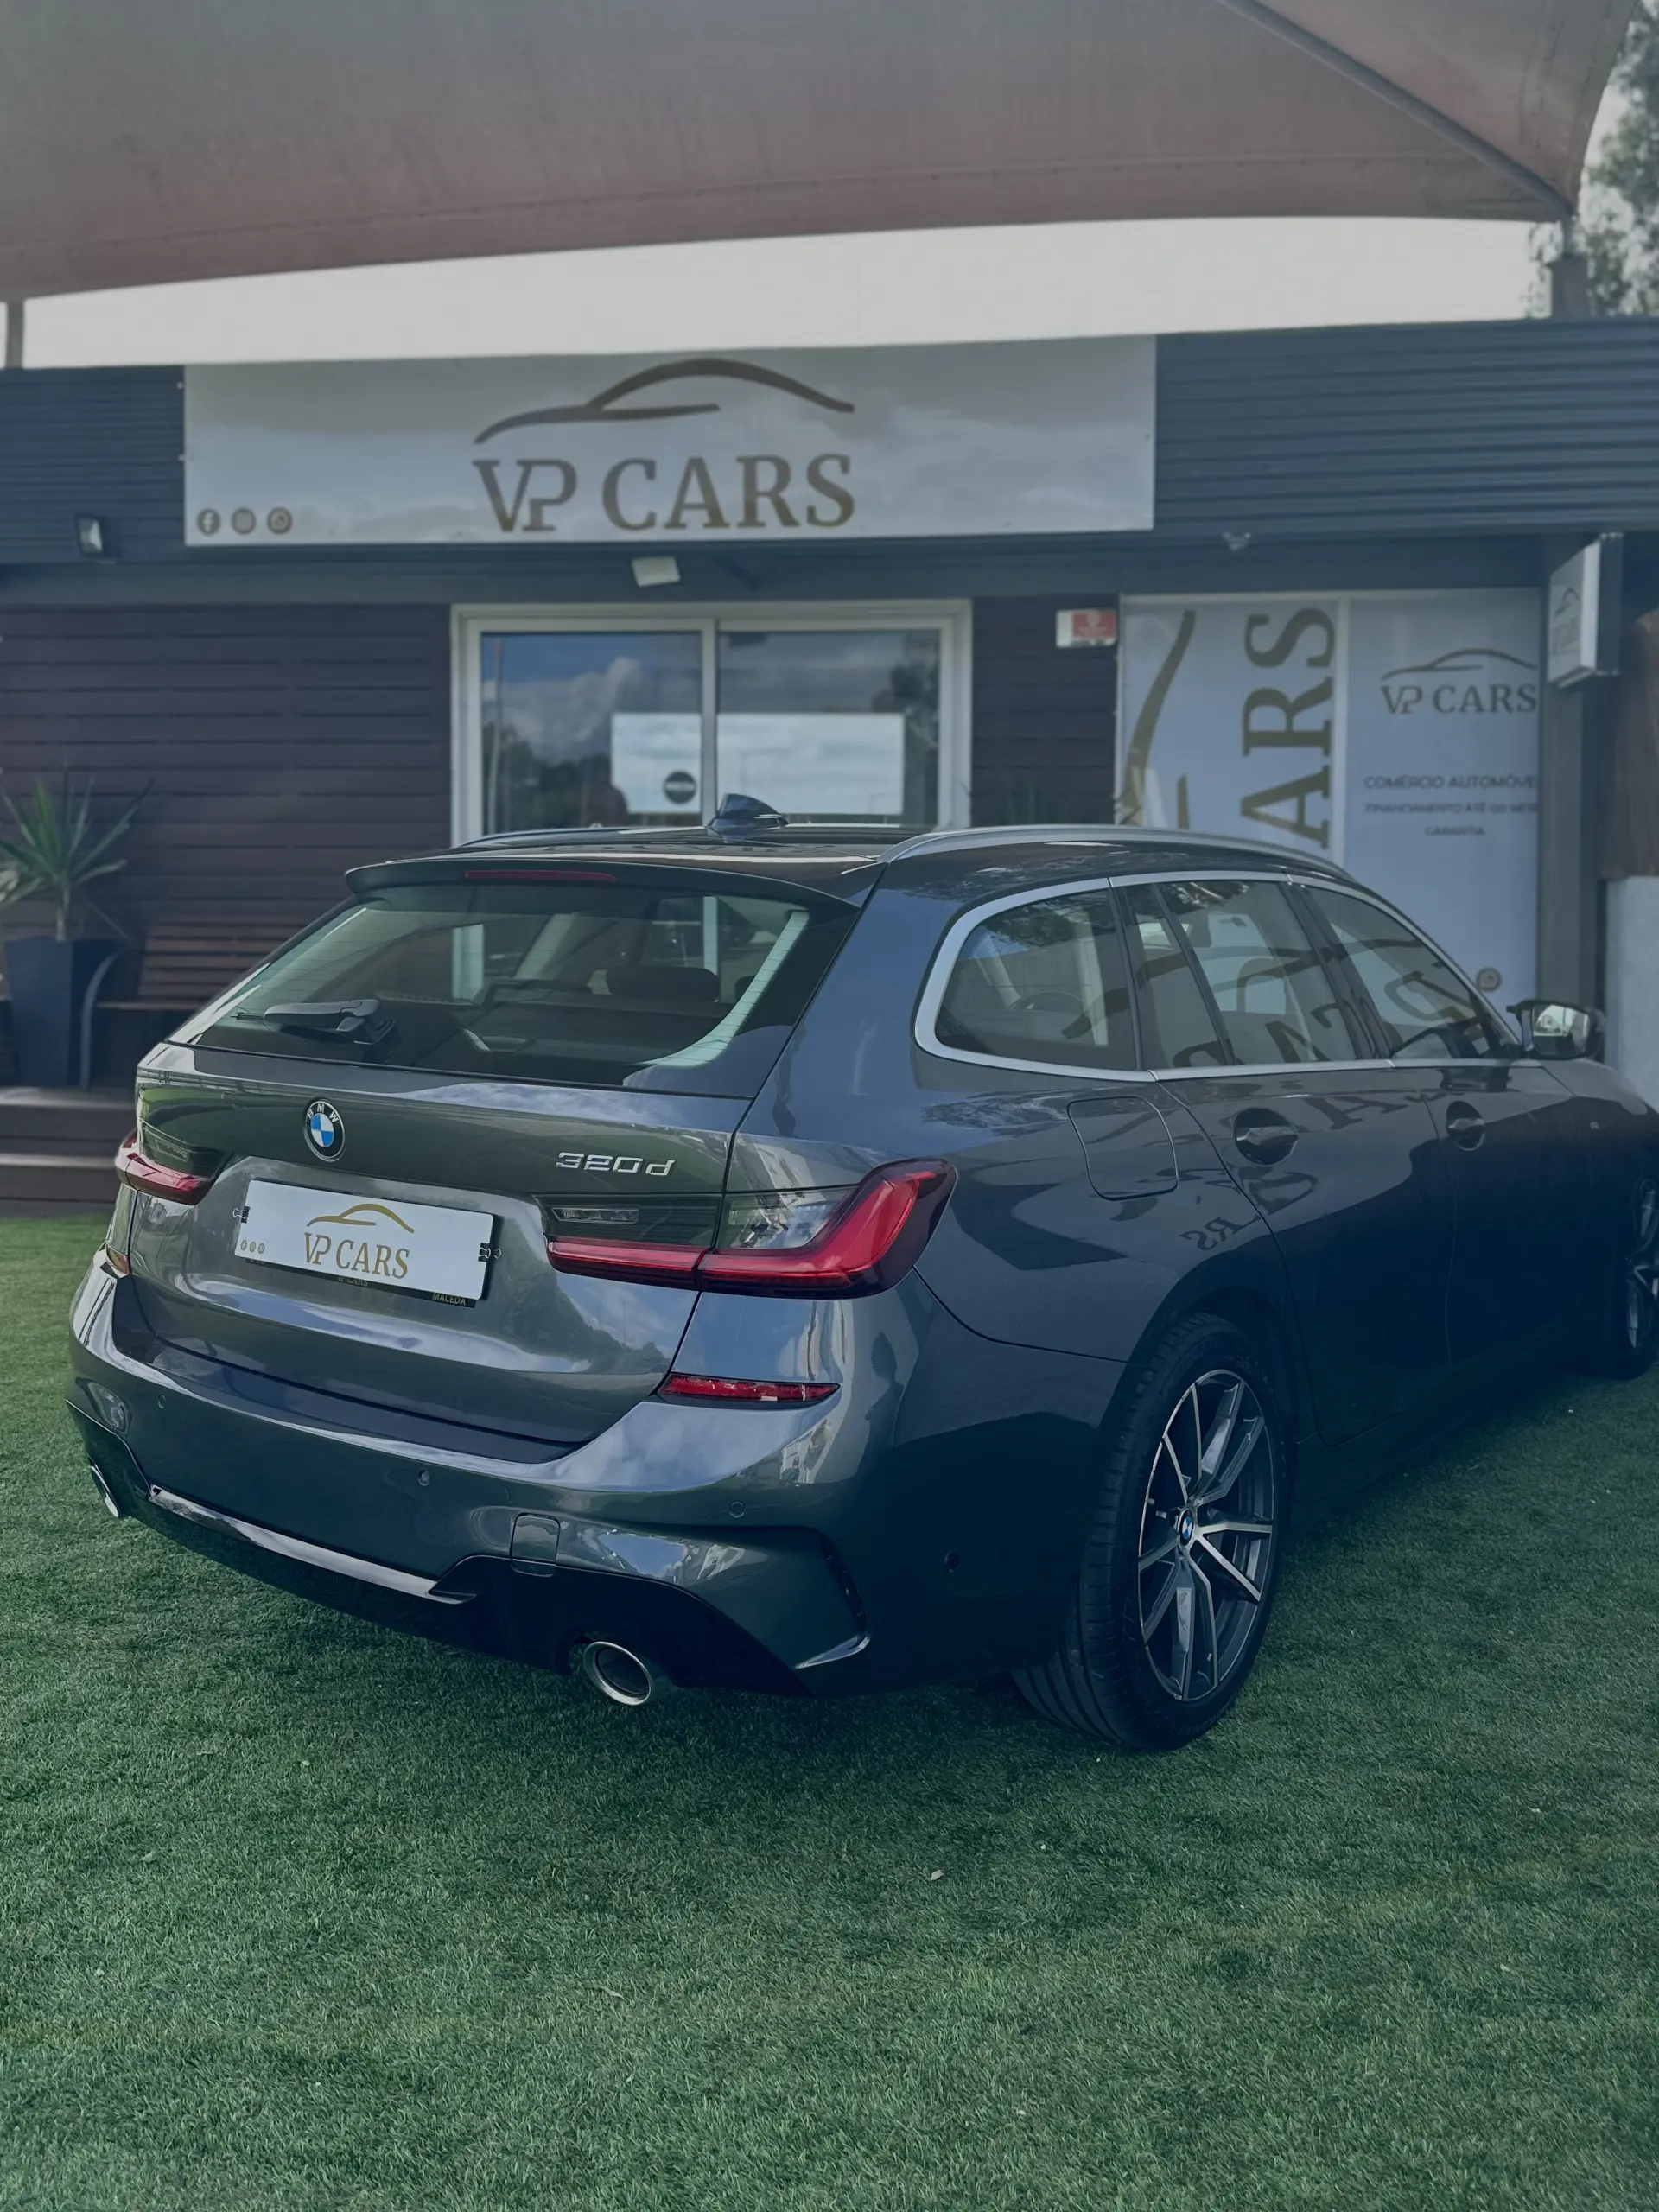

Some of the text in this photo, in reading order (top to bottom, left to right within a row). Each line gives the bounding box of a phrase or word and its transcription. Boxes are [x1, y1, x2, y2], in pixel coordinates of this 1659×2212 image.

[472, 453, 855, 532] VP CARS
[1380, 683, 1536, 715] VP CARS
[307, 1103, 340, 1123] BMW
[556, 1152, 676, 1176] 320d
[303, 1232, 410, 1279] VP CARS
[432, 1292, 467, 1306] MACEDA
